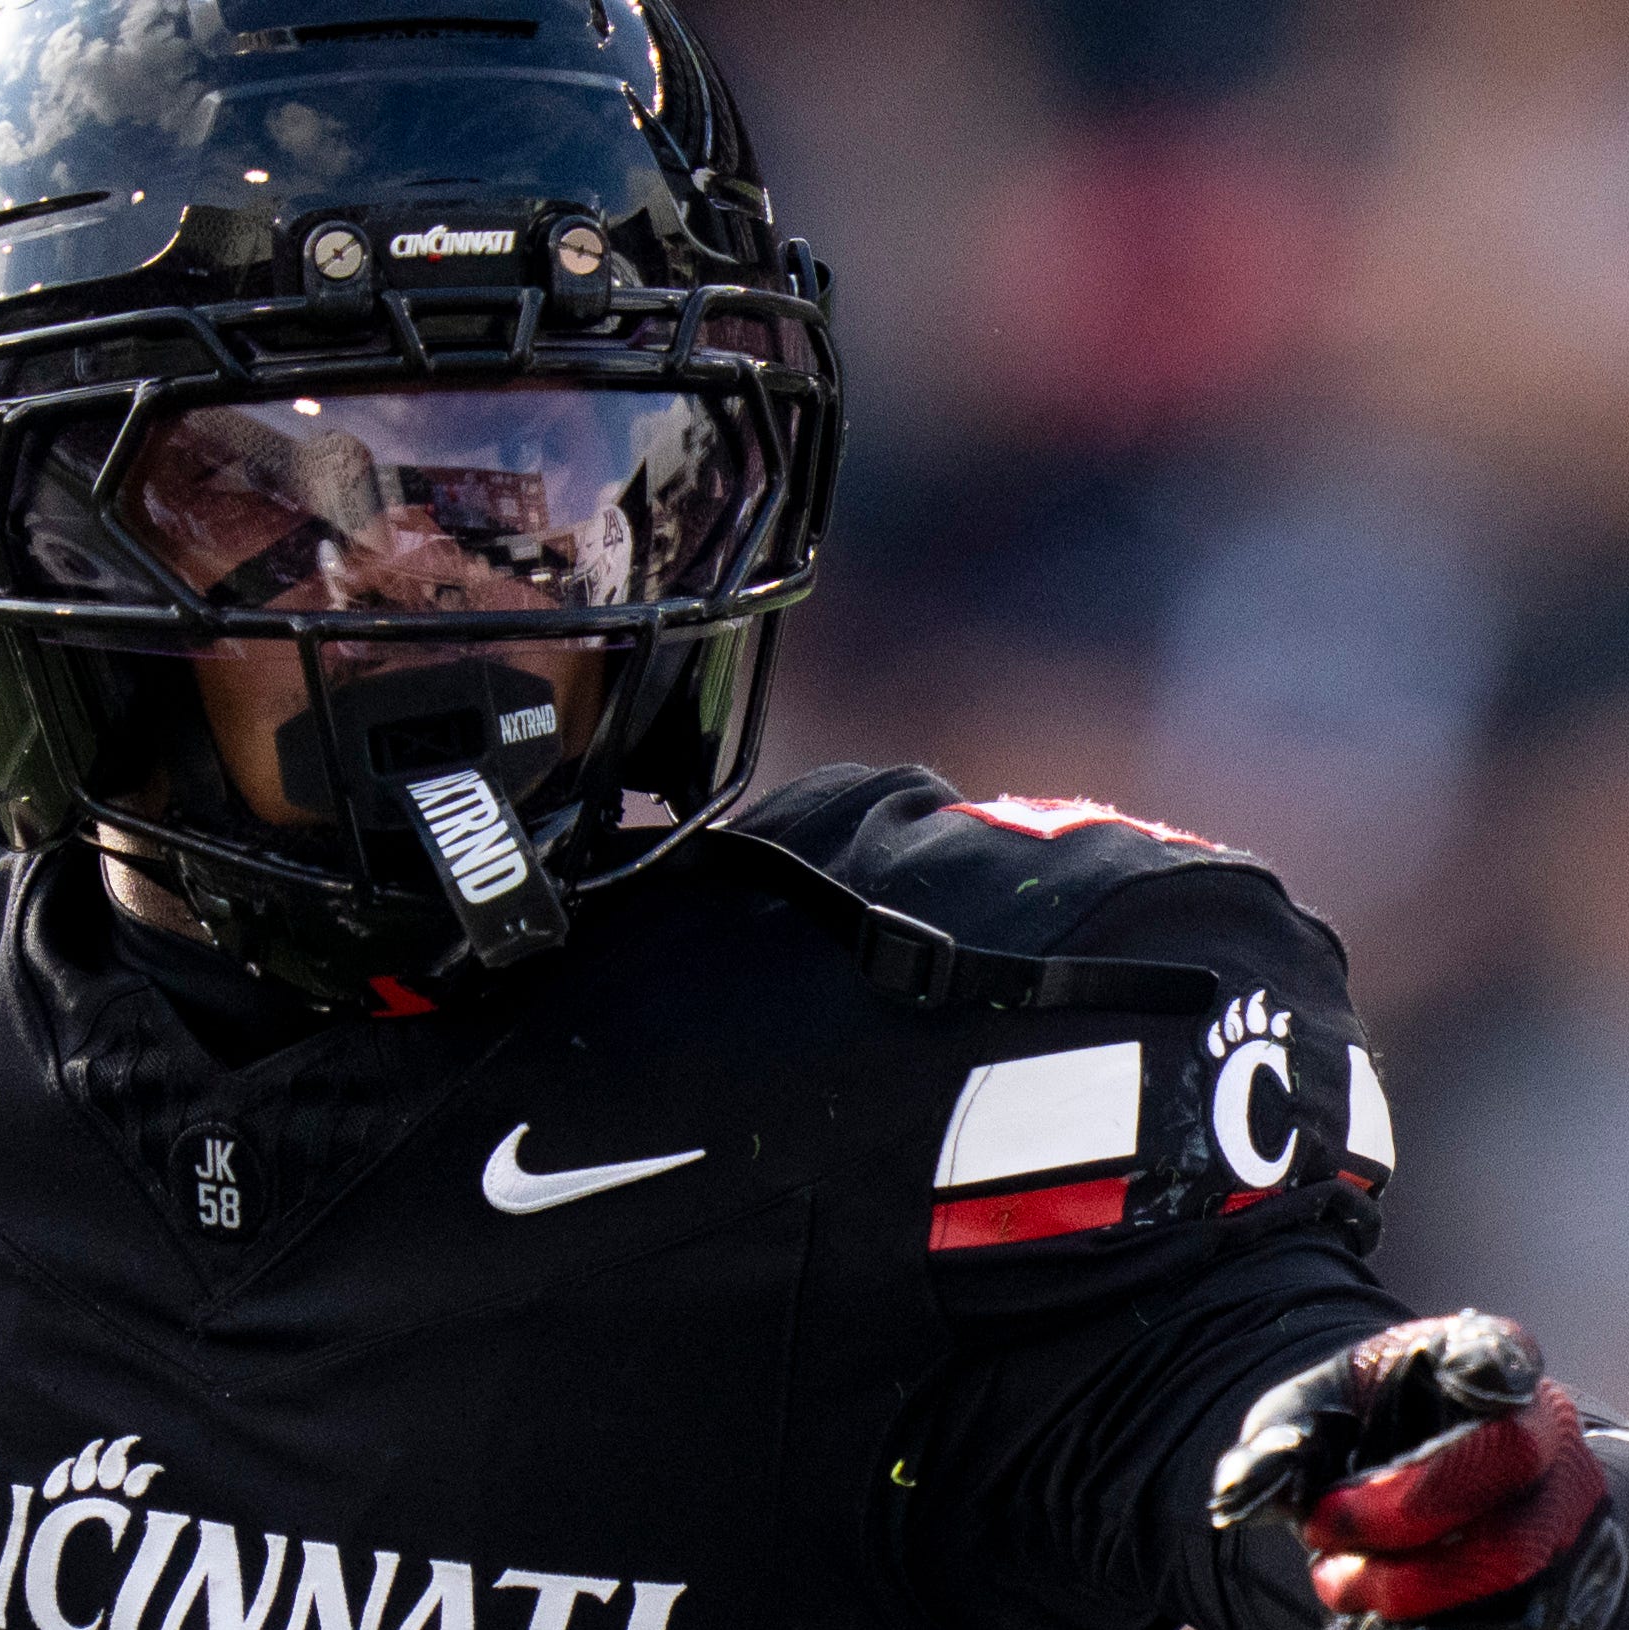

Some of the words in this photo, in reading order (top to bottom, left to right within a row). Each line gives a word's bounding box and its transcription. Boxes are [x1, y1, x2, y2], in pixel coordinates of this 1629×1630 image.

[390, 224, 517, 259] CINCINNATI
[498, 703, 558, 745] NXTRND
[405, 768, 528, 905] NXTRND
[1212, 1039, 1299, 1188] C
[194, 1138, 237, 1183] JK
[197, 1182, 241, 1229] 58
